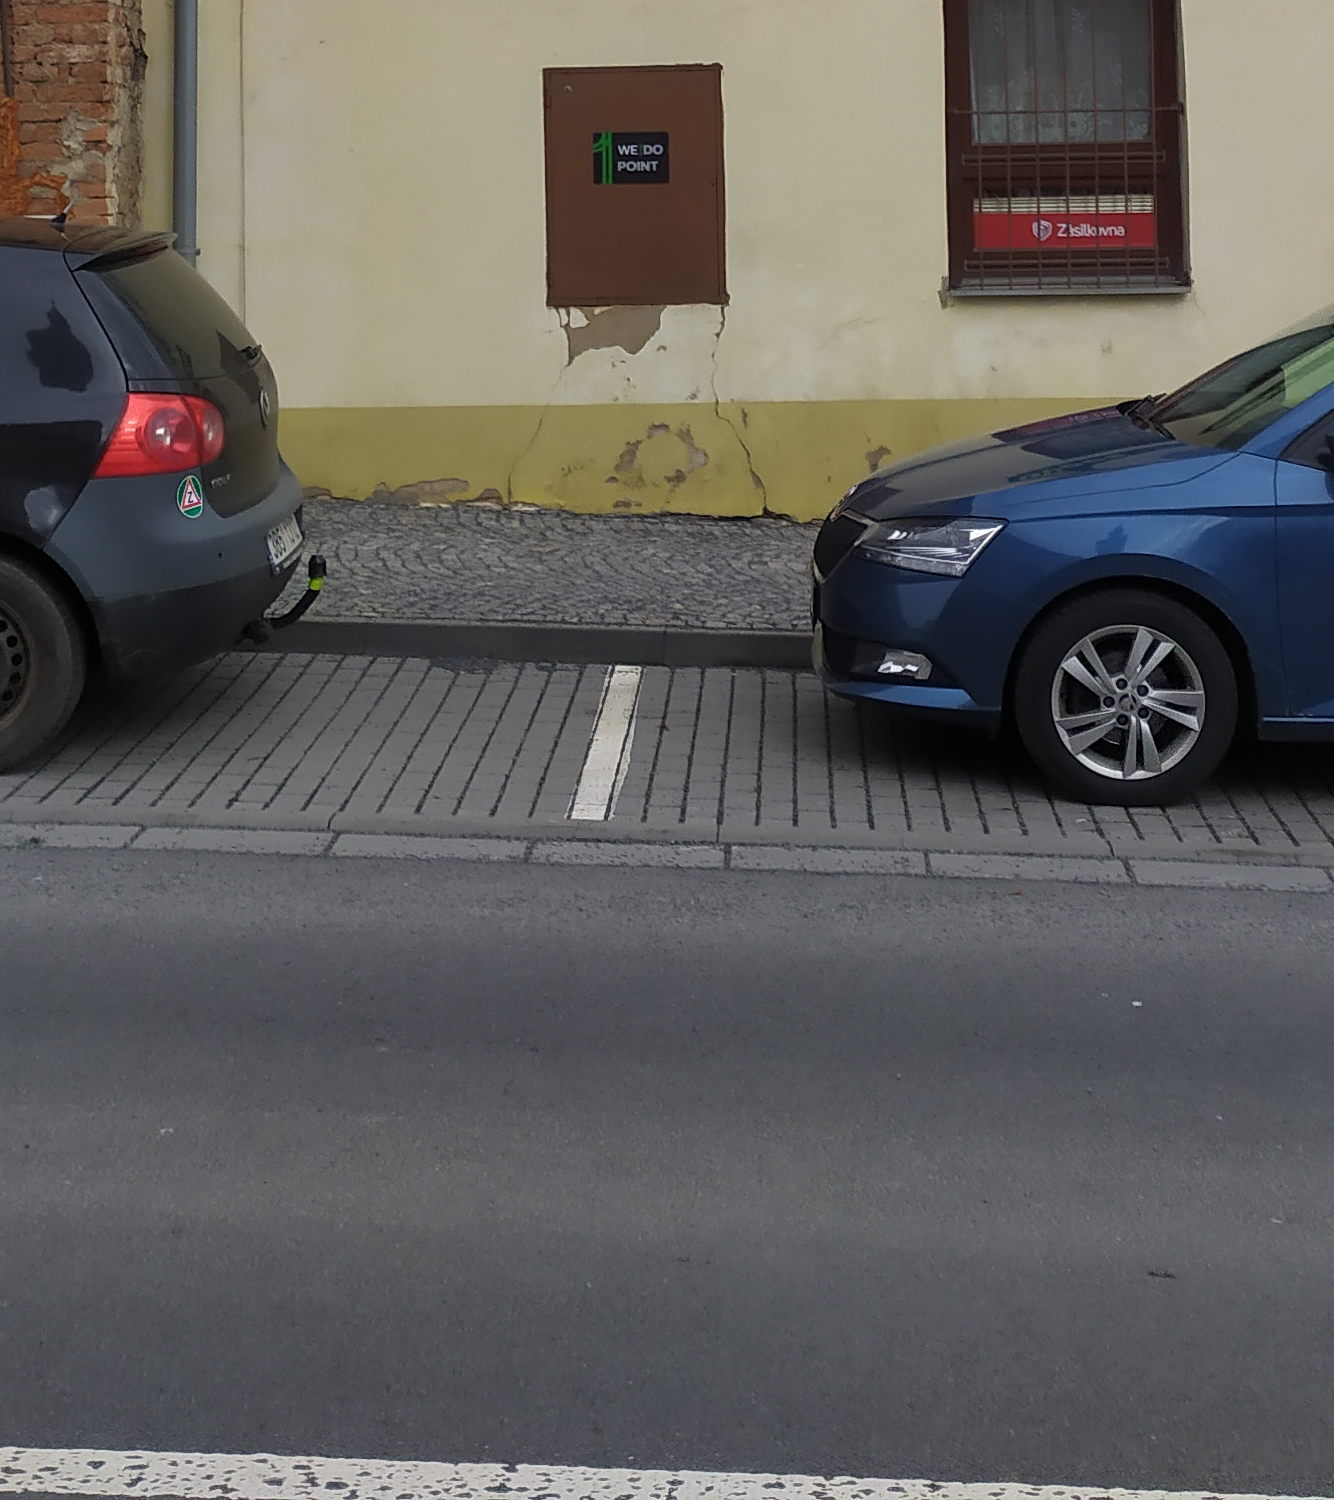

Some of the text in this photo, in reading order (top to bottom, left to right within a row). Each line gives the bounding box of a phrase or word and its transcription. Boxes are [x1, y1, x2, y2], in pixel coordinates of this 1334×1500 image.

[617, 144, 664, 156] WE DO
[617, 160, 659, 172] POINT
[187, 491, 194, 504] Z
